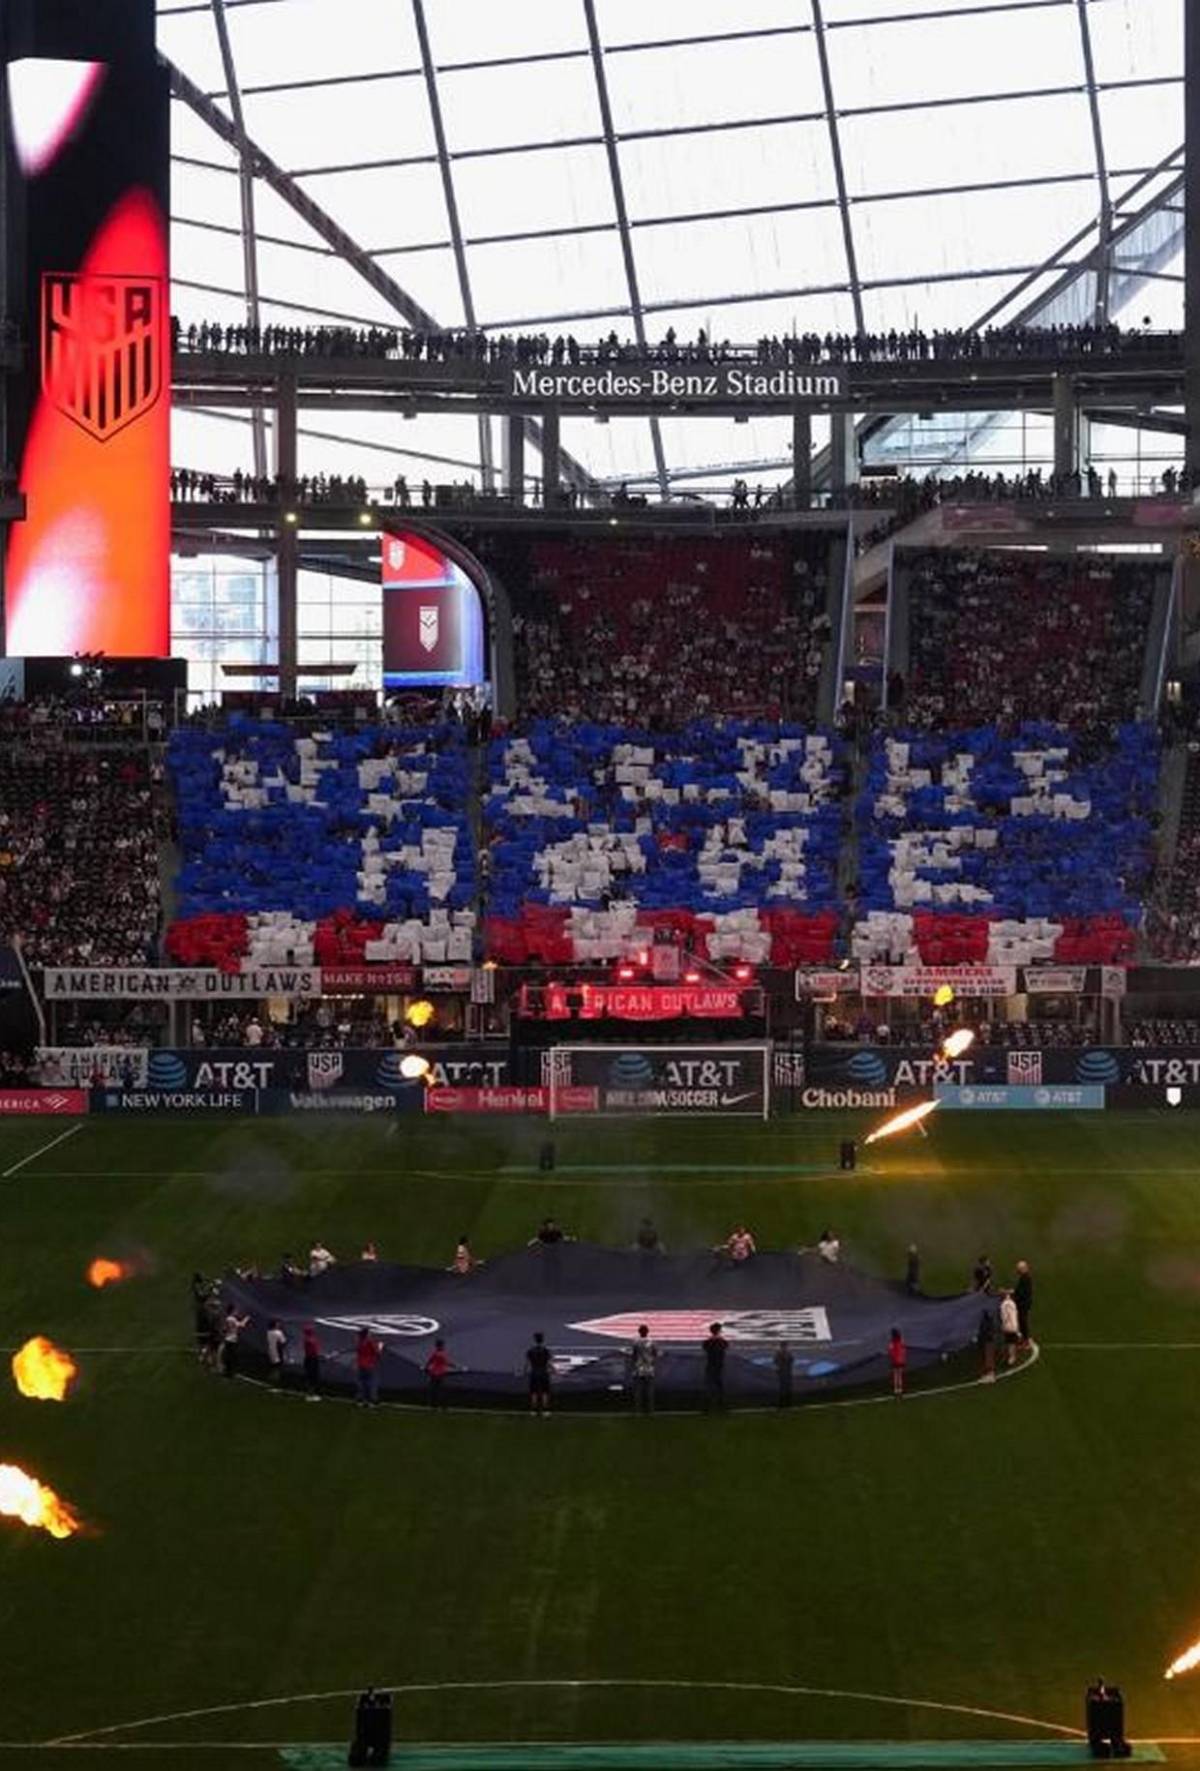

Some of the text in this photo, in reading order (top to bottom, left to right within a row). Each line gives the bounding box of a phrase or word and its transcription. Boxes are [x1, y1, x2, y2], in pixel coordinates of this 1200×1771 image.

[511, 369, 840, 396] Mercedes-Benz Stadium
[53, 973, 313, 993] AMERICAN OUTLAWS
[323, 972, 364, 985] MAKE
[661, 992, 738, 1011] OUTLAWS
[70, 1053, 142, 1065] AMERICAN
[194, 1061, 274, 1089] AT&T
[665, 1060, 741, 1087] AT&T
[893, 1059, 974, 1086] AT&T
[122, 1093, 242, 1108] NEW YORK LIFE
[478, 1089, 544, 1107] Henkel
[801, 1087, 896, 1108] Chobani
[1051, 1091, 1083, 1103] AT&T
